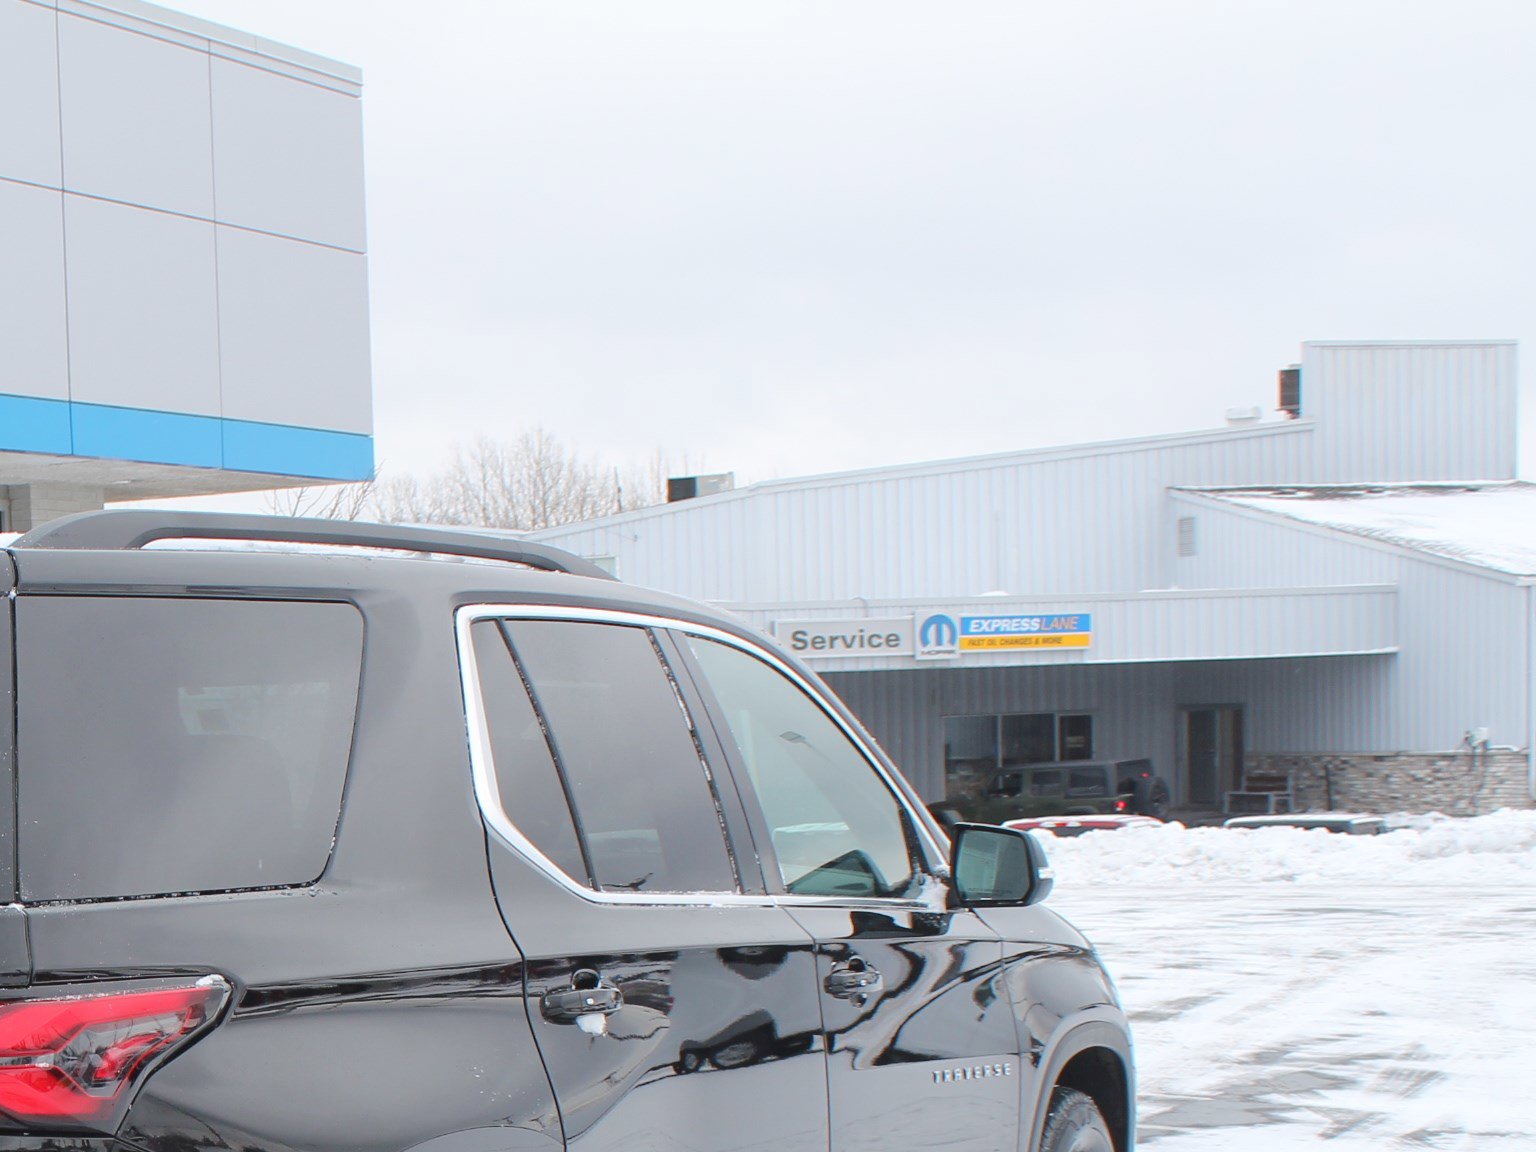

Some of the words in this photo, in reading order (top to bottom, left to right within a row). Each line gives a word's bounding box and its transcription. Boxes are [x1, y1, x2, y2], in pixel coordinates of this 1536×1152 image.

[791, 628, 901, 651] Service
[968, 639, 985, 647] FAST
[999, 638, 1033, 646] CHANGES
[932, 1063, 1011, 1084] TRAVERSE
